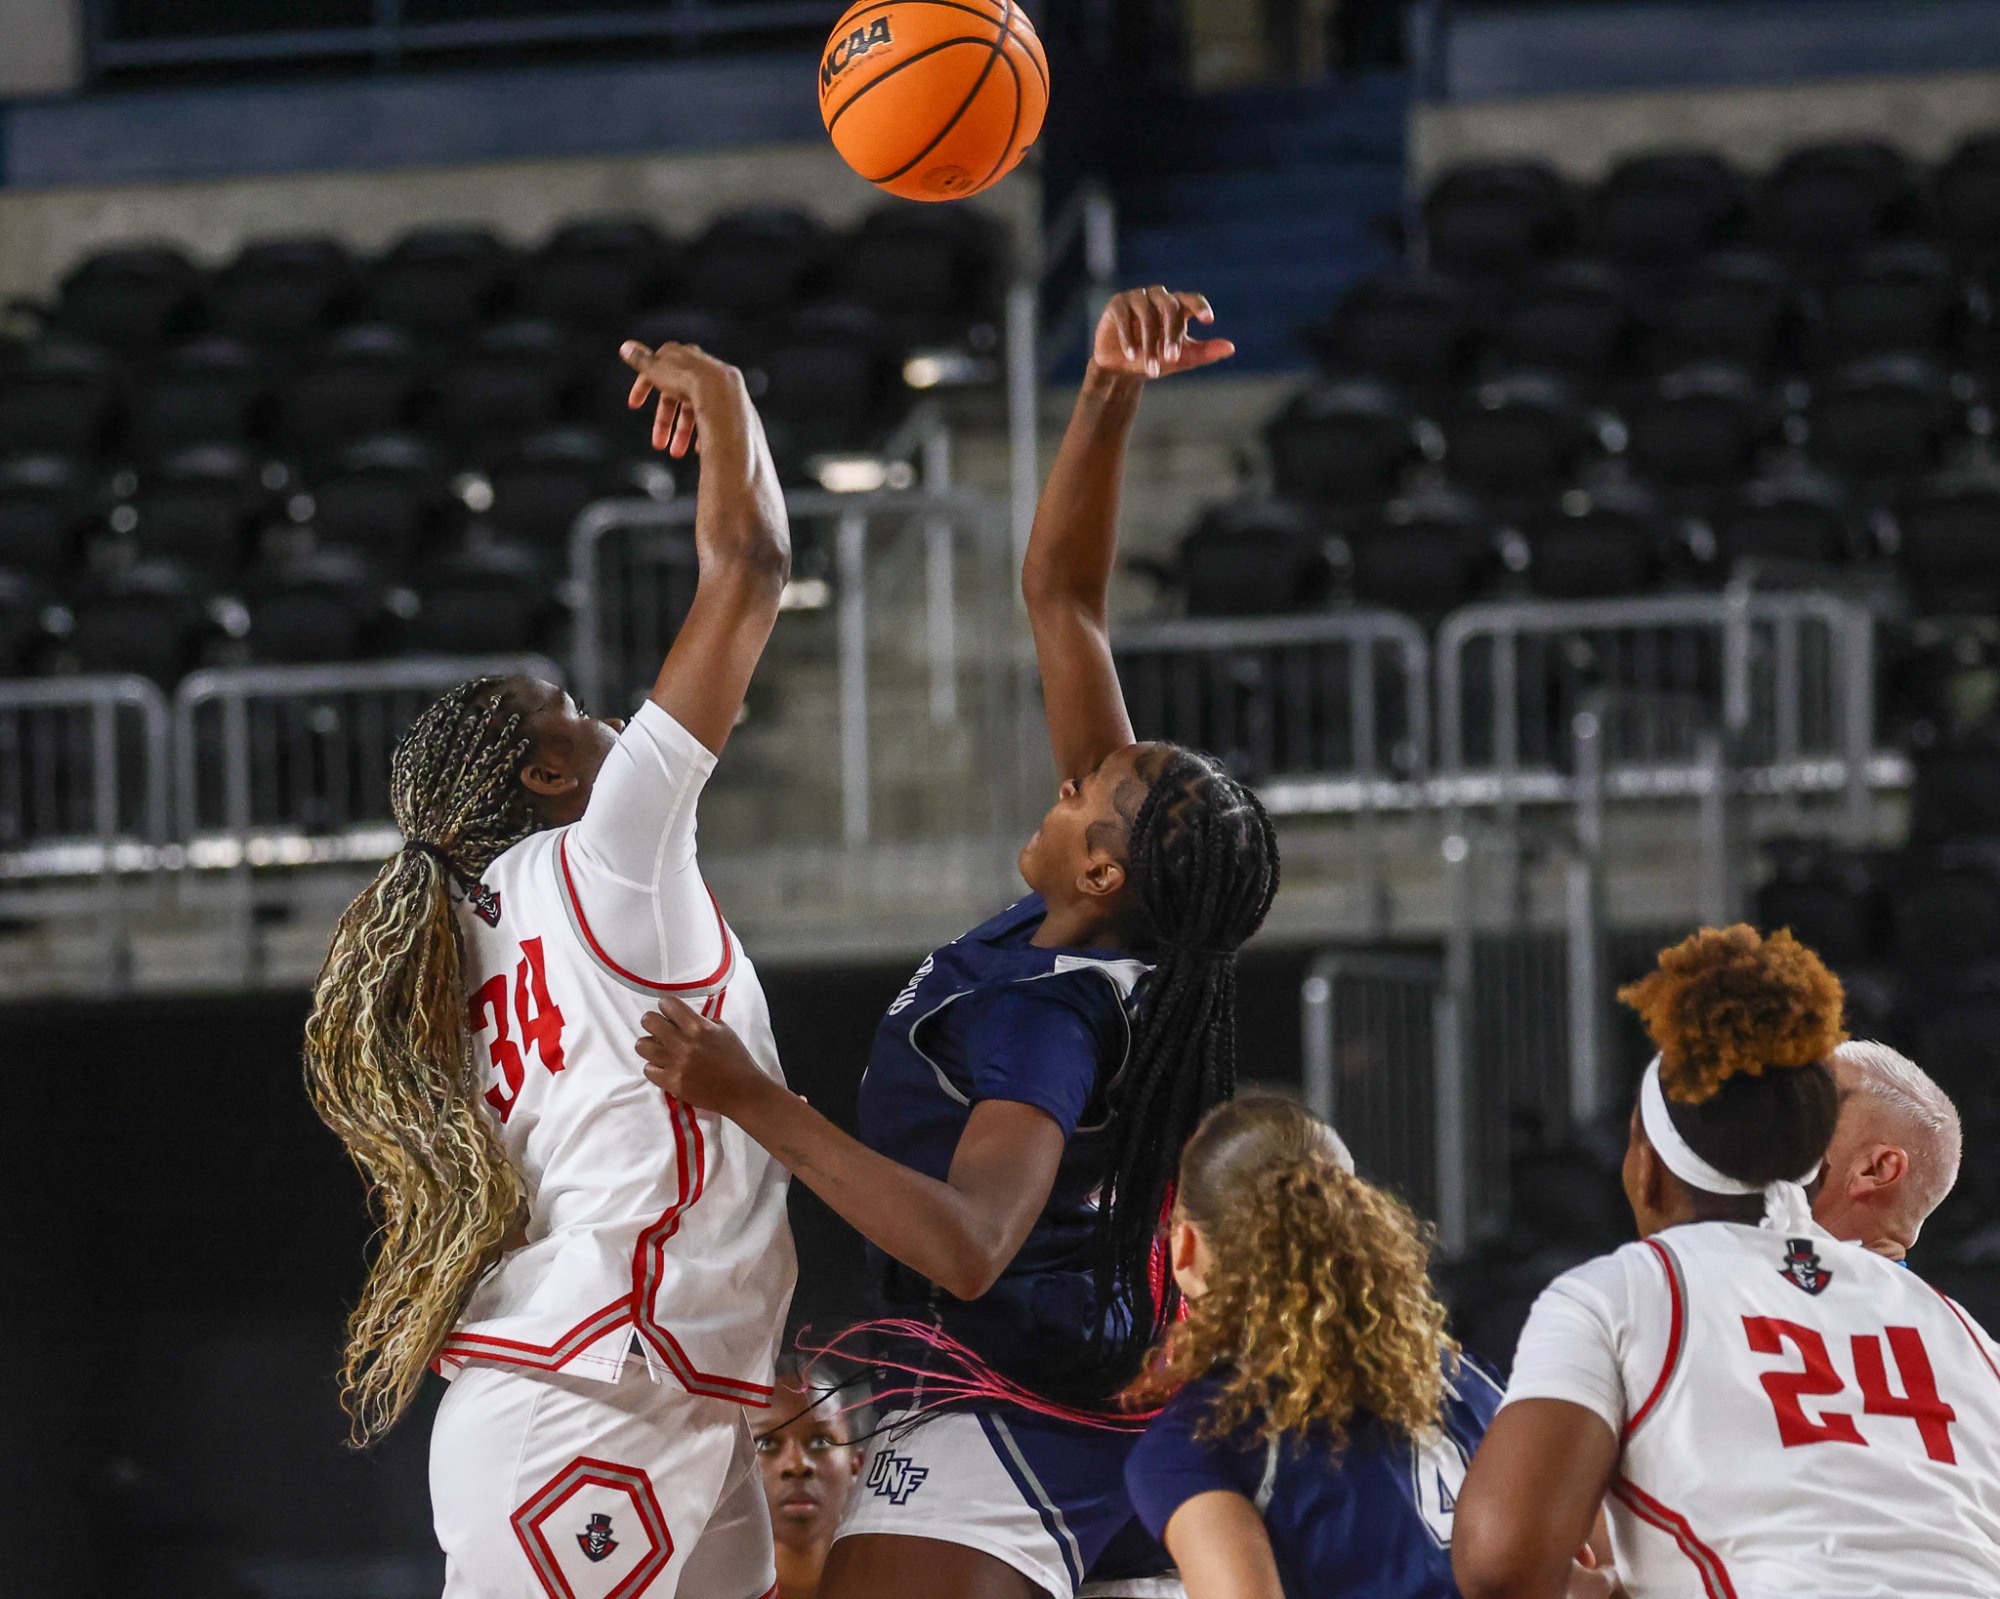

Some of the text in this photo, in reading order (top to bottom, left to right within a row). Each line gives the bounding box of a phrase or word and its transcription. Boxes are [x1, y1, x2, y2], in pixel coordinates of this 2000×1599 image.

[821, 15, 893, 100] NCAA
[467, 935, 566, 1124] 34
[1741, 1314, 1958, 1466] 24
[866, 1449, 929, 1505] UNF
